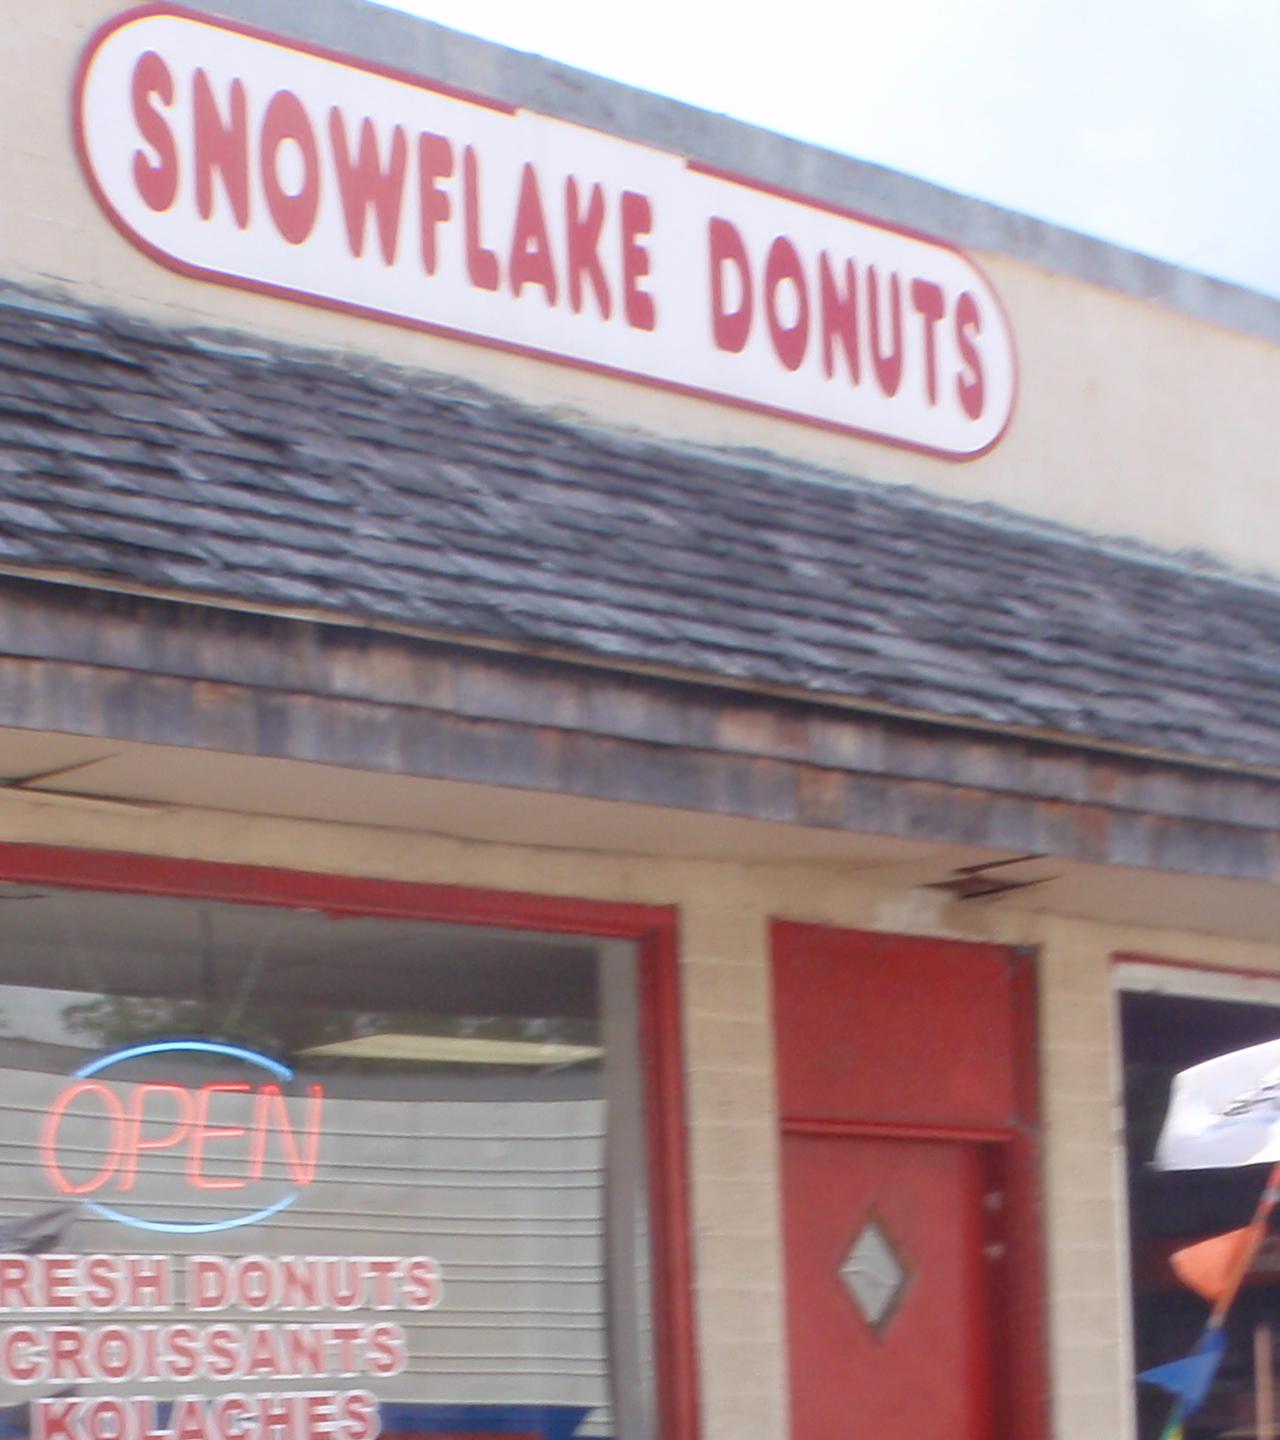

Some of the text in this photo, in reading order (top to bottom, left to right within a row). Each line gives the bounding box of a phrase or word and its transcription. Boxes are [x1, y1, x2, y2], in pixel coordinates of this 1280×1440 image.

[132, 50, 986, 422] SNOWFLAKE DONUTS
[40, 1082, 324, 1195] OPEN
[187, 1256, 443, 1313] DONUTS
